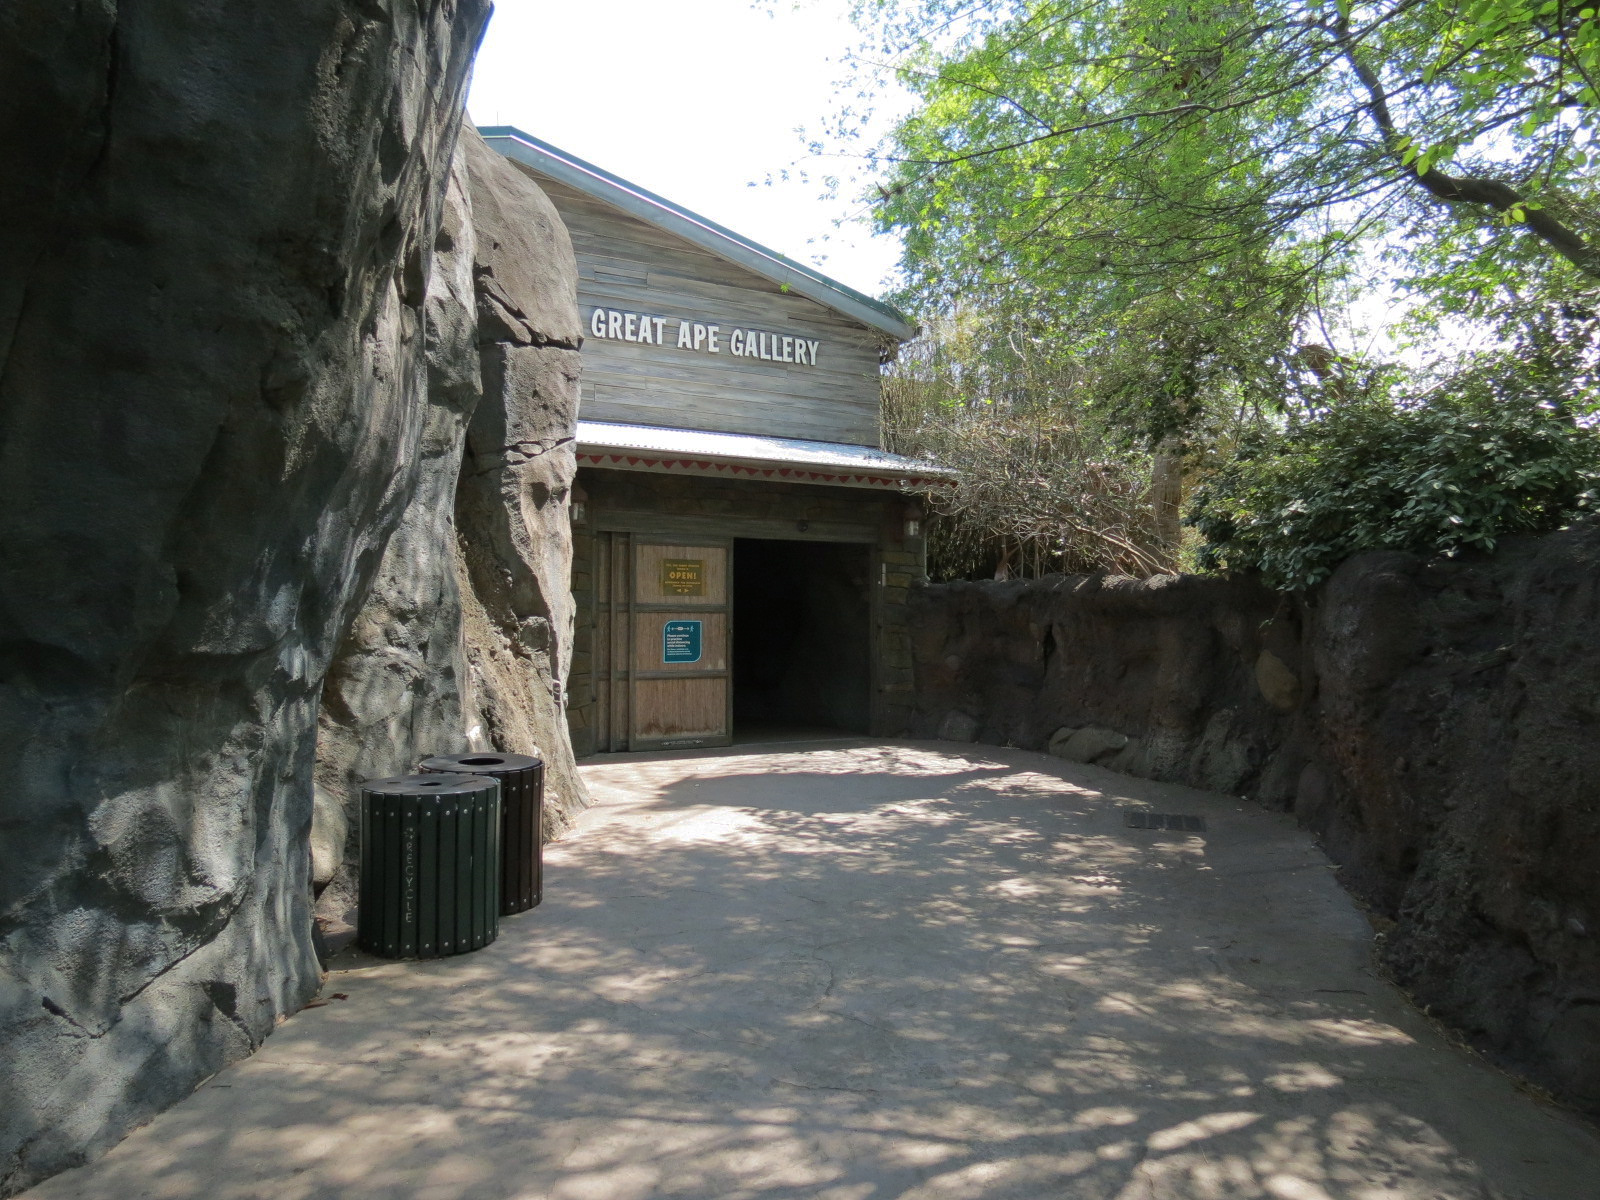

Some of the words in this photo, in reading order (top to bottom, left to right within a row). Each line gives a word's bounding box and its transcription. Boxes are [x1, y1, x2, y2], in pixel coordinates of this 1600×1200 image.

[591, 308, 667, 345] GREAT
[677, 321, 720, 353] APE
[730, 329, 820, 366] GALLERY
[669, 571, 697, 580] OPEN!
[405, 841, 414, 923] RECYCLE
